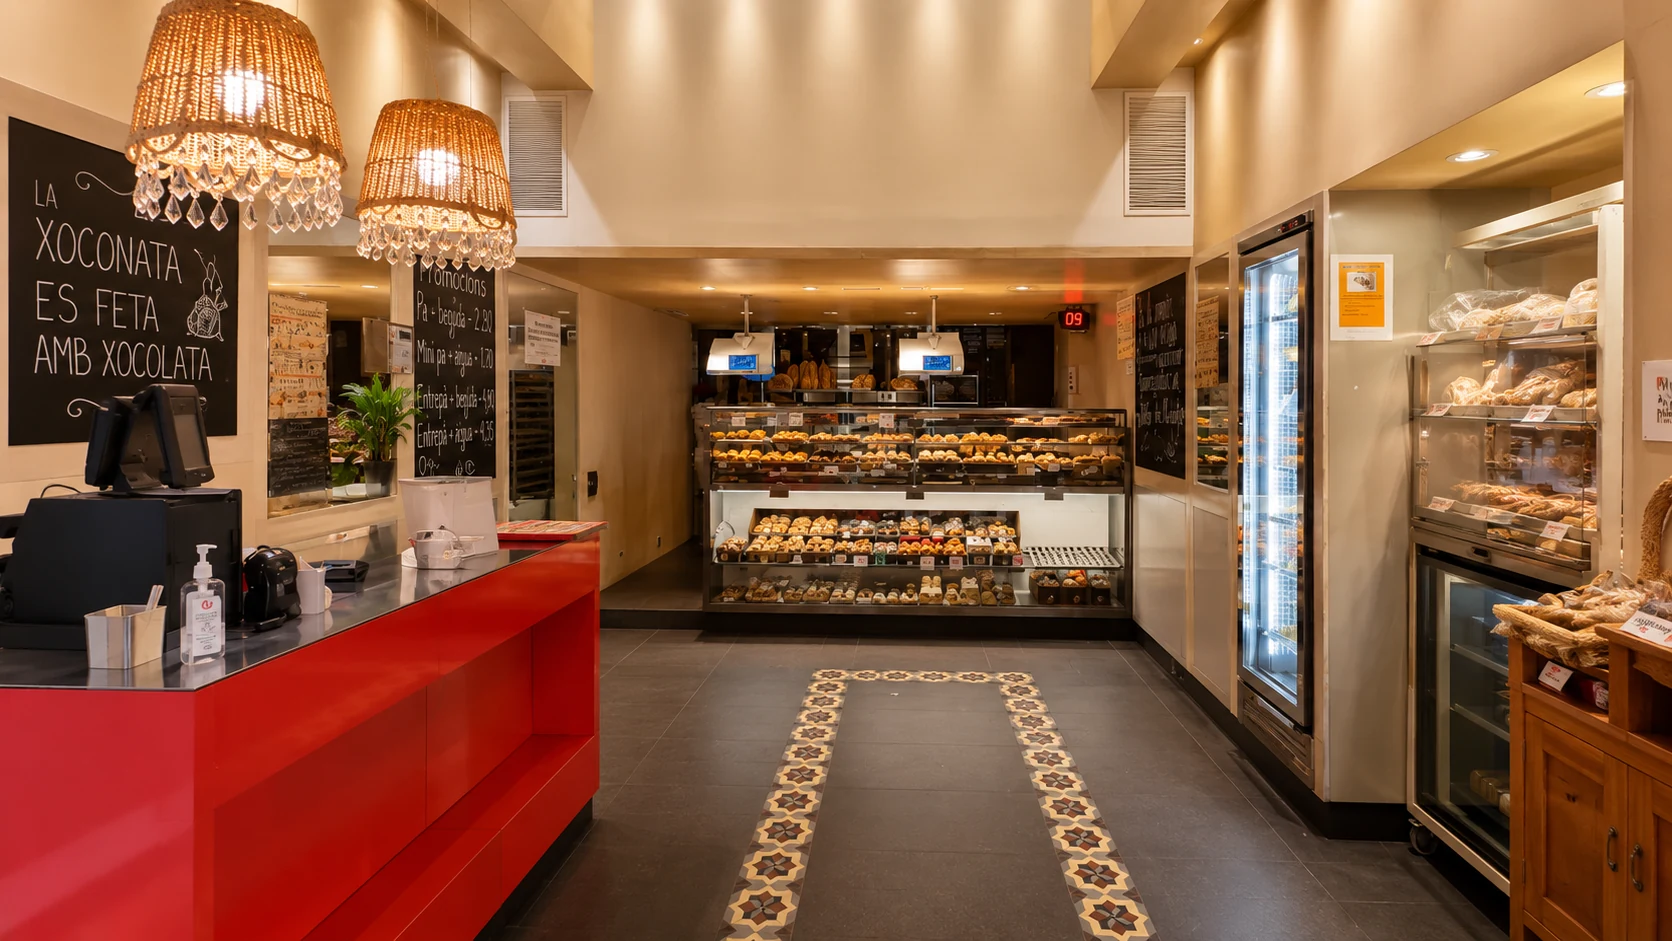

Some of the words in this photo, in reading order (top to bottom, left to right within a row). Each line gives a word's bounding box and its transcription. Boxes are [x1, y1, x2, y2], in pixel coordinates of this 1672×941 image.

[35, 179, 58, 210] LA
[35, 217, 183, 284] XOCONATA
[36, 280, 79, 323] ES
[96, 288, 159, 332] FETA
[416, 290, 428, 322] Pa
[1065, 312, 1083, 326] 09
[34, 334, 92, 376] AMB
[102, 339, 213, 381] XOCOLATA
[417, 339, 435, 364] Mini
[436, 348, 447, 377] pa
